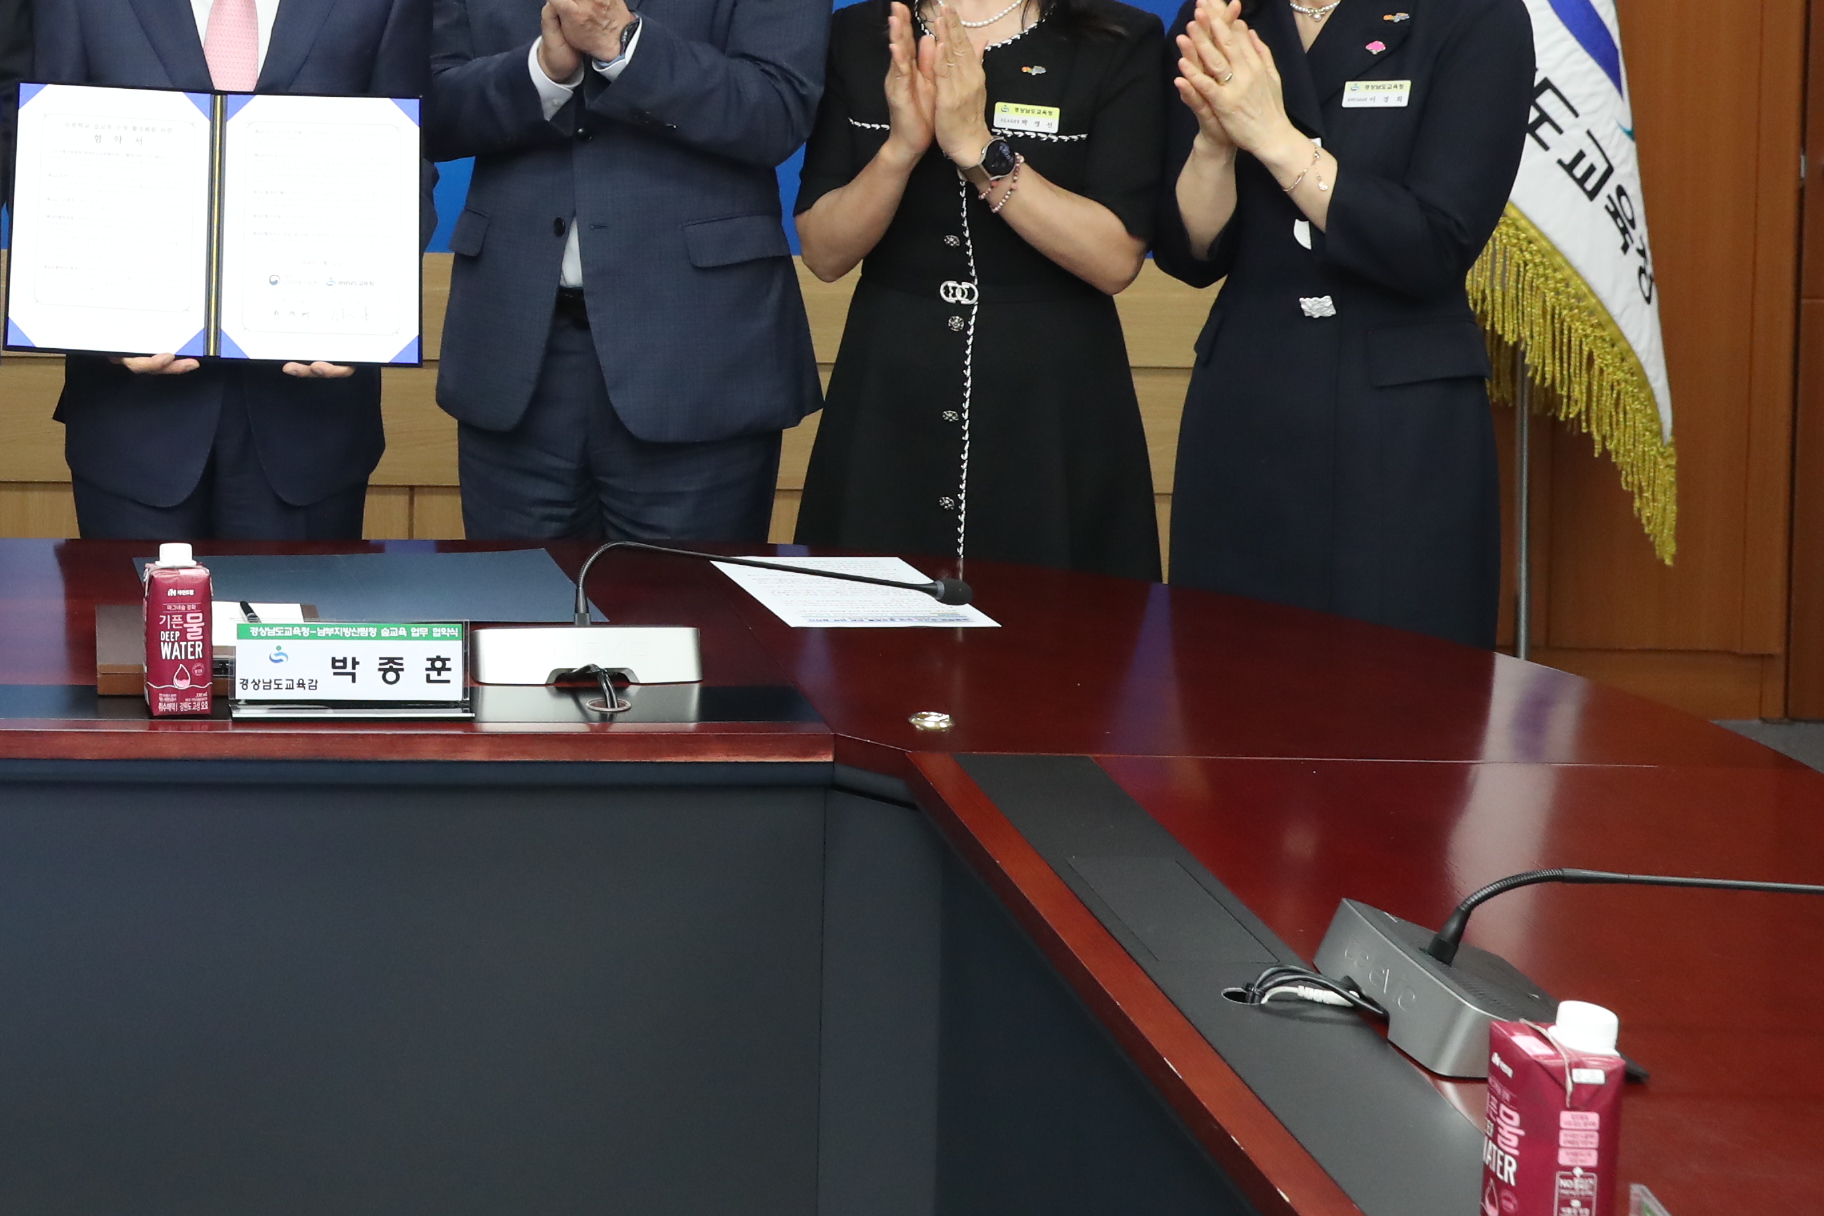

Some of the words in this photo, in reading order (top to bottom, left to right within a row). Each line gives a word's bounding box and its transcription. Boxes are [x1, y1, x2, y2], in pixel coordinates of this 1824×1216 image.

[160, 630, 180, 642] DEEP
[380, 627, 407, 637] 숲교육
[410, 627, 429, 637] 업무
[432, 626, 459, 637] 협약식
[160, 641, 203, 660] WATER
[239, 677, 319, 691] 경상남도교육감
